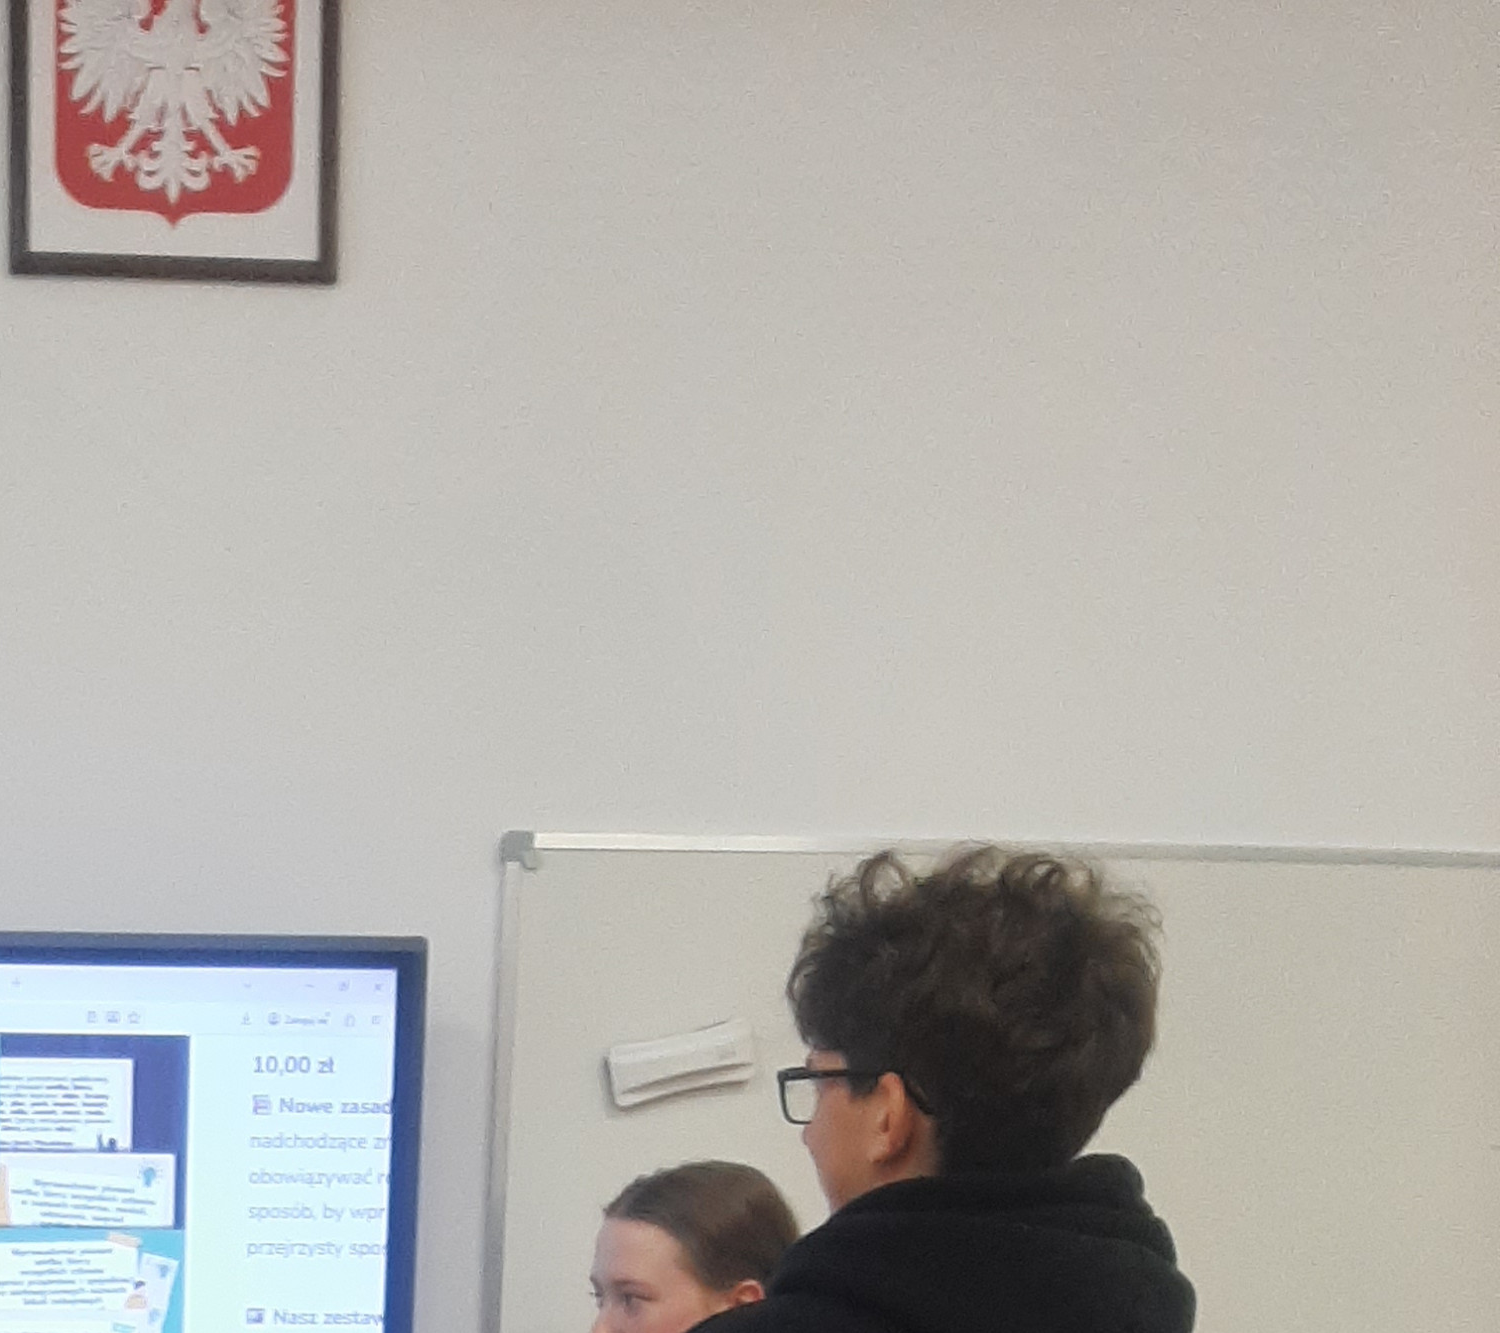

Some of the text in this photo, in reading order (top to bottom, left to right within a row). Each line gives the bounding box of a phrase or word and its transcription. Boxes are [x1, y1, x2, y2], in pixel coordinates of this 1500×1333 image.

[253, 1056, 335, 1076] 10,00 zł
[279, 1097, 333, 1114] Nowe
[322, 1203, 345, 1222] by
[274, 1309, 319, 1325] Nasz
